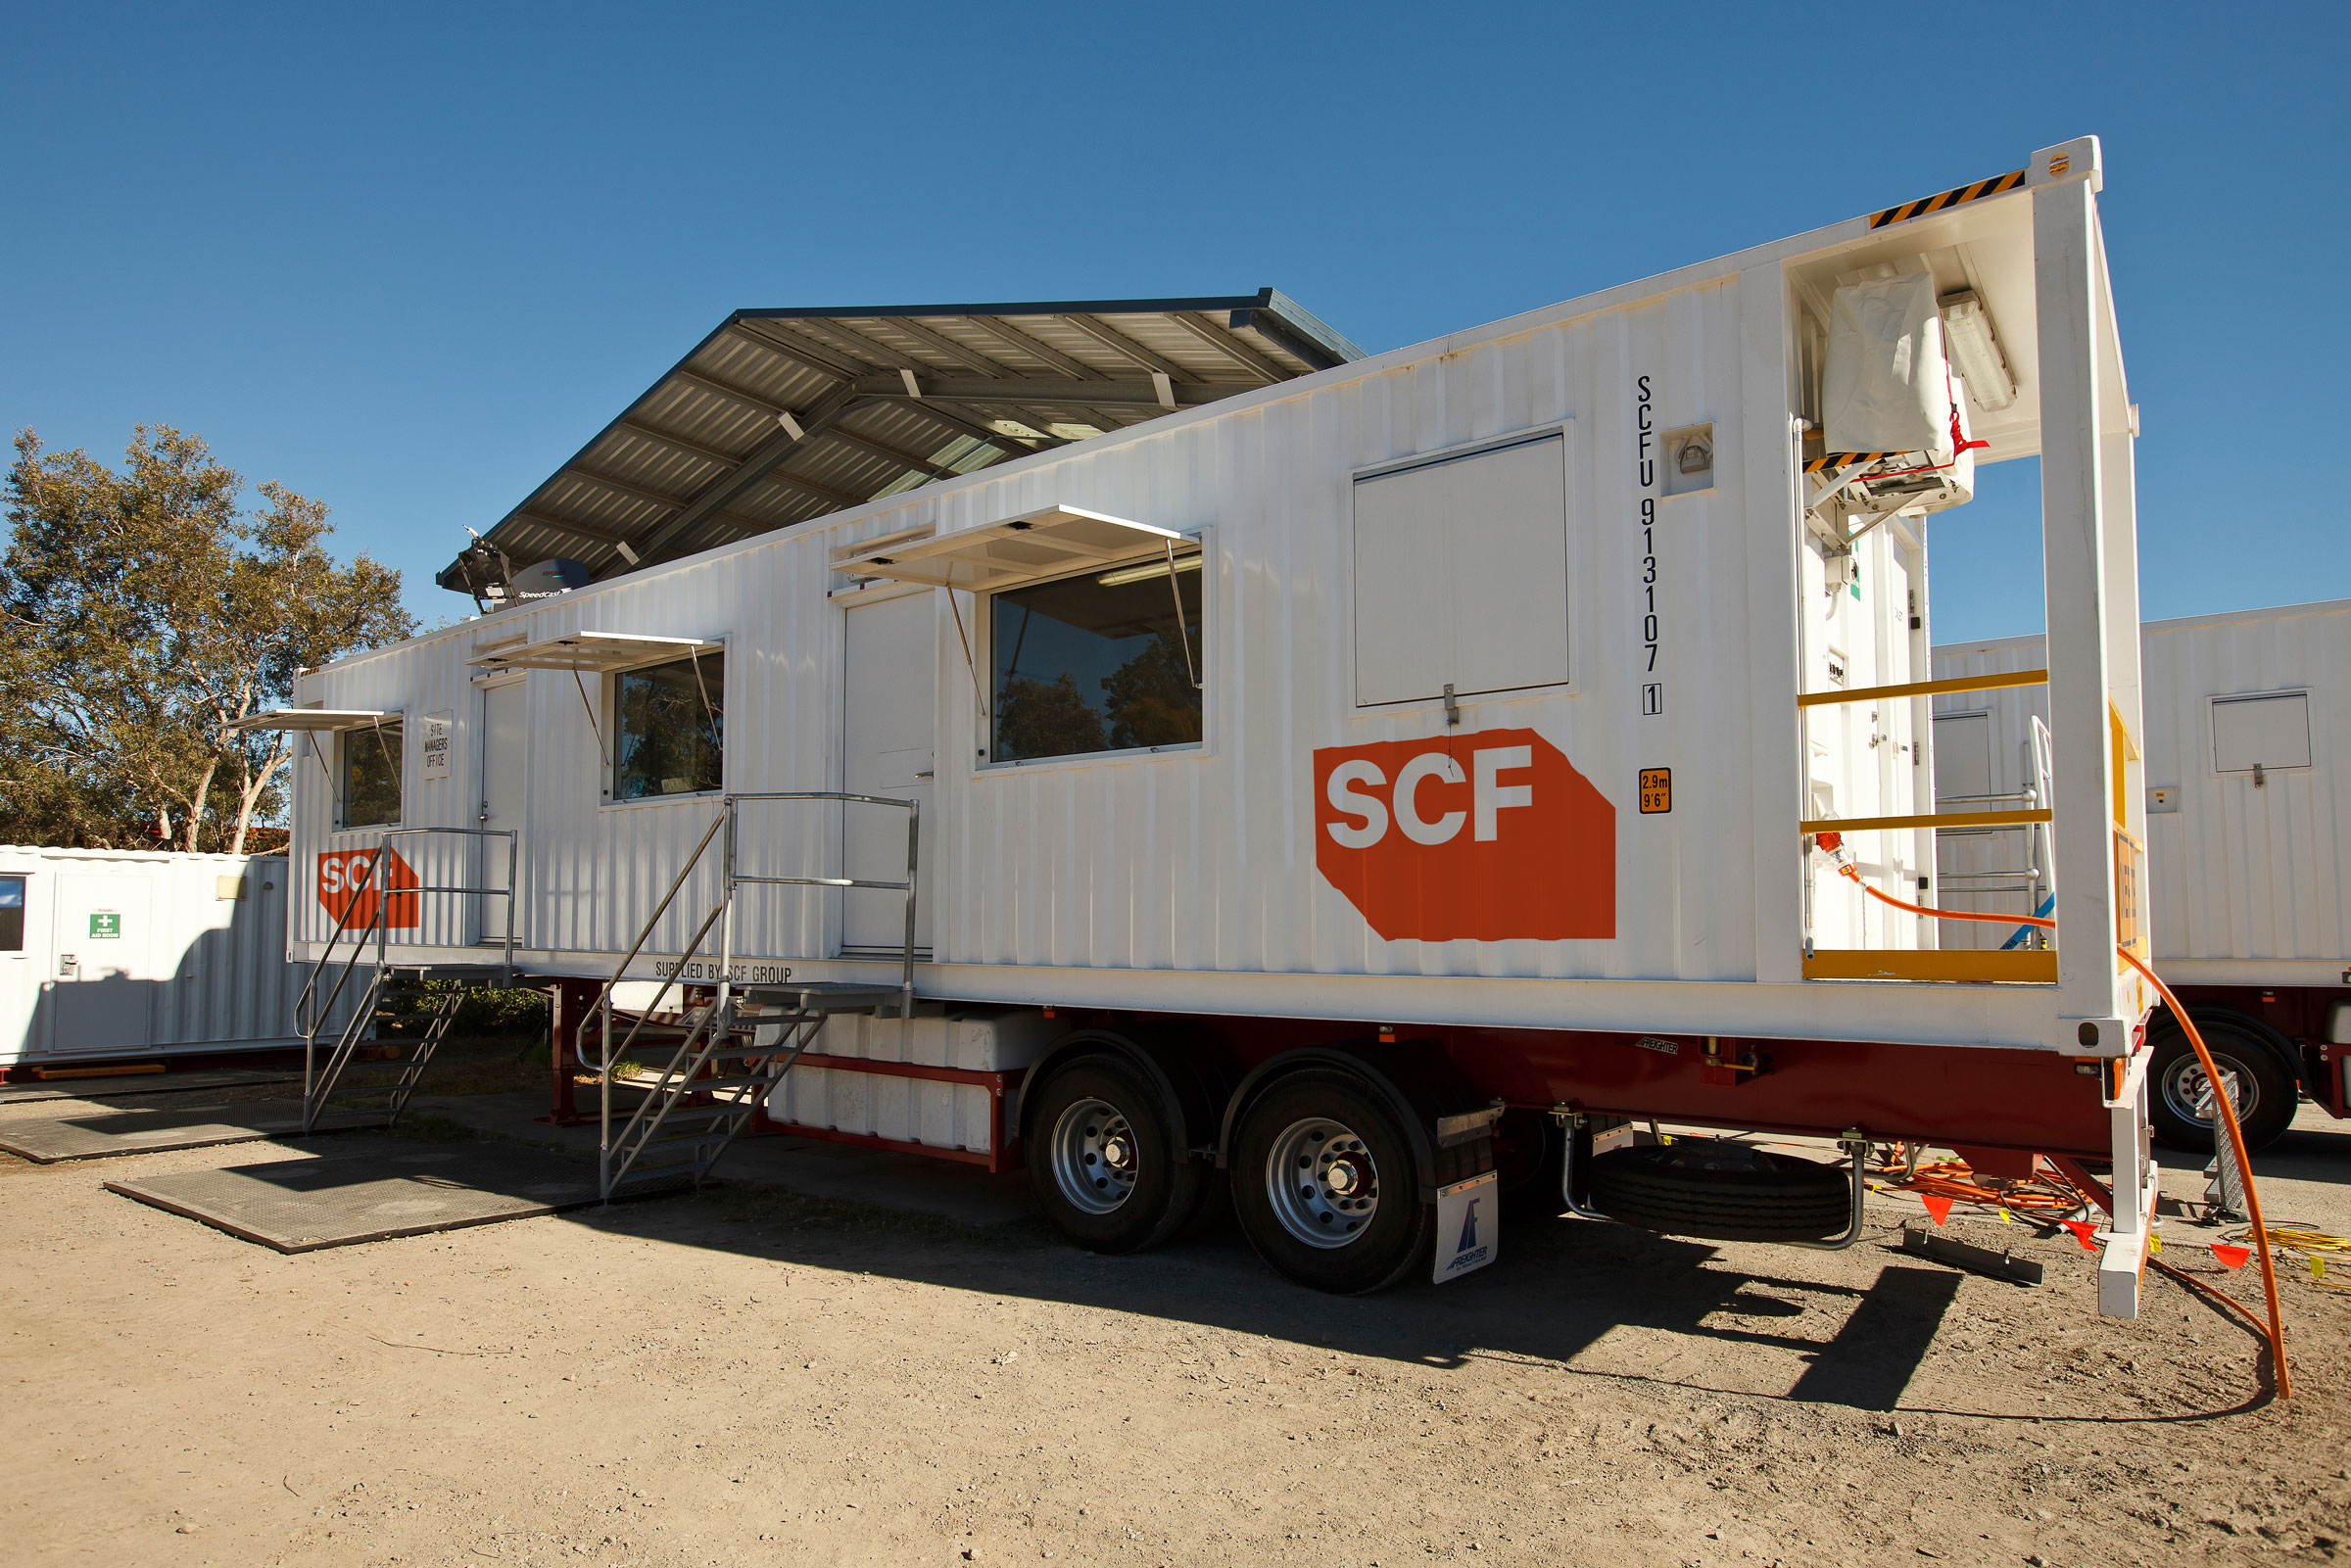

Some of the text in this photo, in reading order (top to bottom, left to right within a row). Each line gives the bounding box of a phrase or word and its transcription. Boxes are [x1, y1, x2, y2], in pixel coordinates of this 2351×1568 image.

[1638, 375, 1658, 714] SCFU 913107 1
[518, 590, 561, 598] SpeedCast
[430, 723, 443, 736] SITE
[424, 737, 449, 752] MANAGERS
[426, 753, 445, 767] OFFICE
[1642, 774, 1668, 788] 2.9m
[1325, 744, 1533, 849] SCF
[655, 961, 792, 984] SUPLIED BY SCF GROUP
[1637, 1038, 1678, 1054] FREIGHTER
[1446, 1245, 1488, 1271] FREIGHTER
